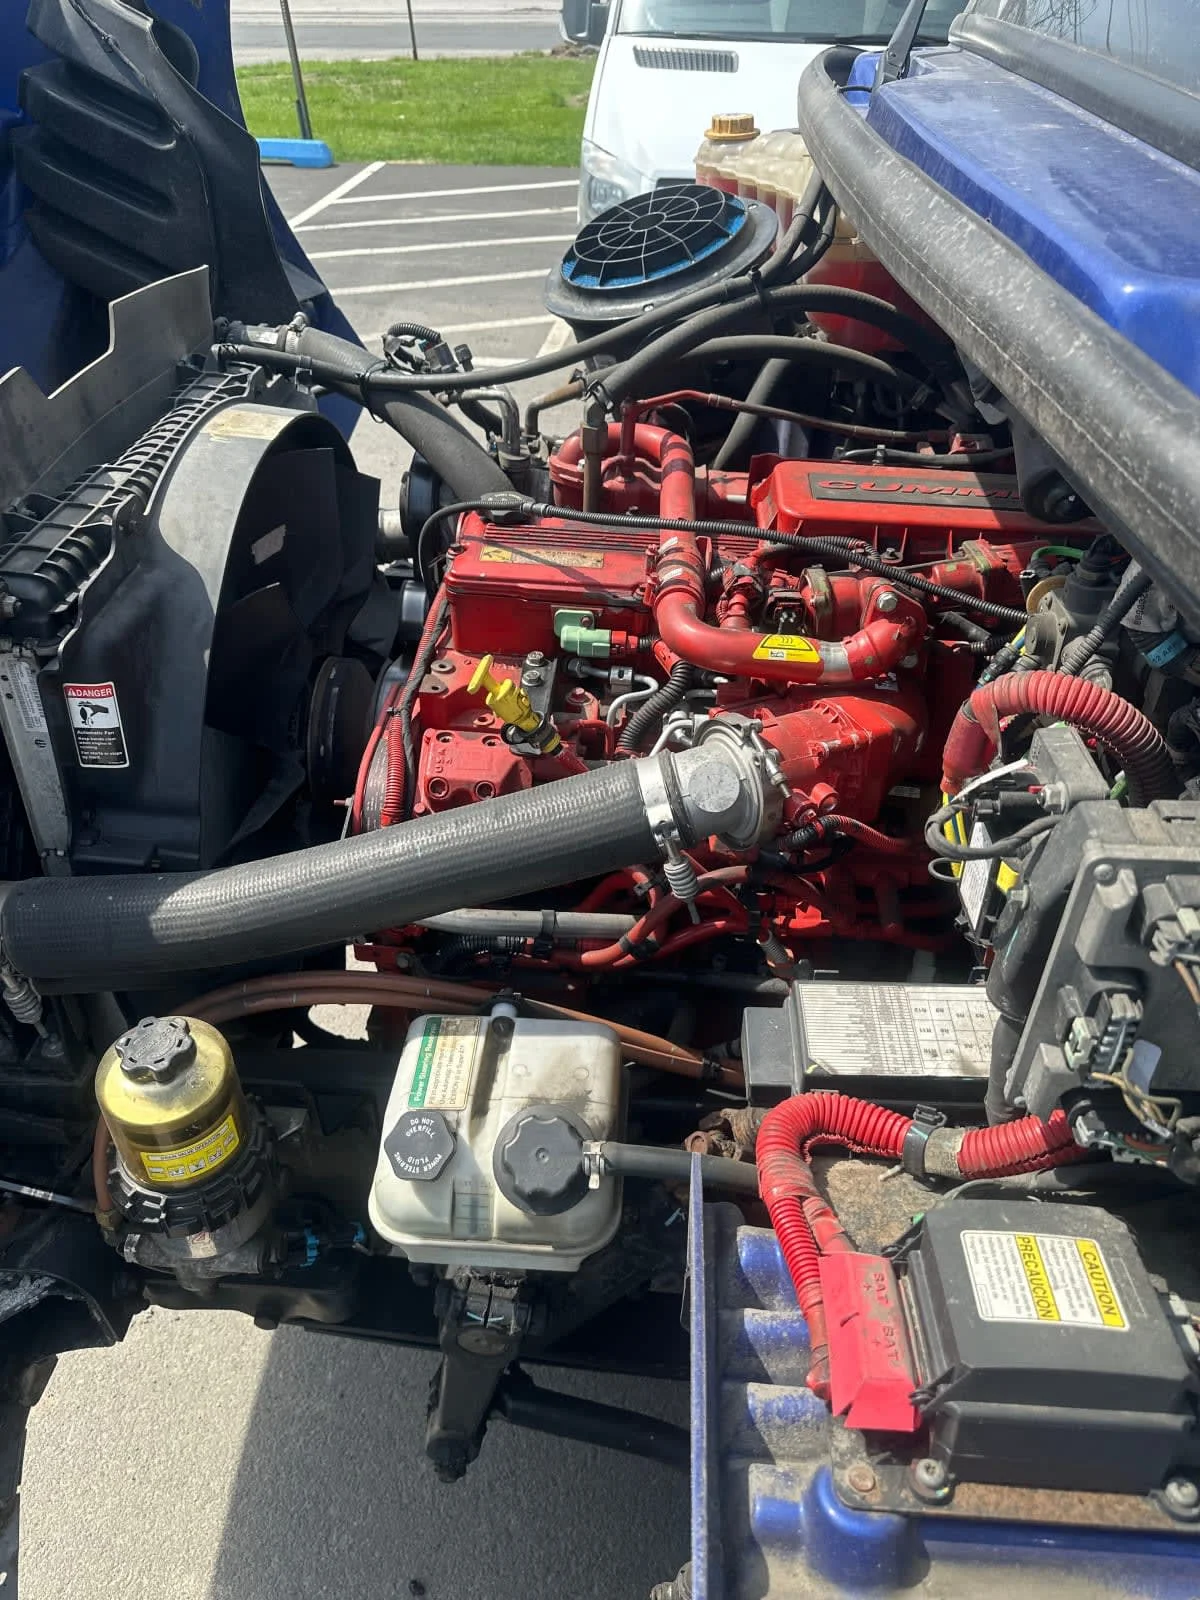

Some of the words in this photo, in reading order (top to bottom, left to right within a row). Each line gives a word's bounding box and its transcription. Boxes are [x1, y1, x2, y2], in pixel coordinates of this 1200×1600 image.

[818, 480, 1020, 498] CUMMI
[76, 688, 112, 697] DANGER
[414, 1082, 424, 1102] Power
[410, 1118, 418, 1126] DO
[422, 1116, 434, 1126] NOT
[406, 1125, 436, 1138] OVERFILL
[394, 1152, 420, 1174] STEERING
[408, 1156, 429, 1166] FLUID
[424, 1153, 442, 1172] POWER
[1018, 1236, 1056, 1318] PRECAUCIÓN
[1083, 1251, 1116, 1316] CAUTION
